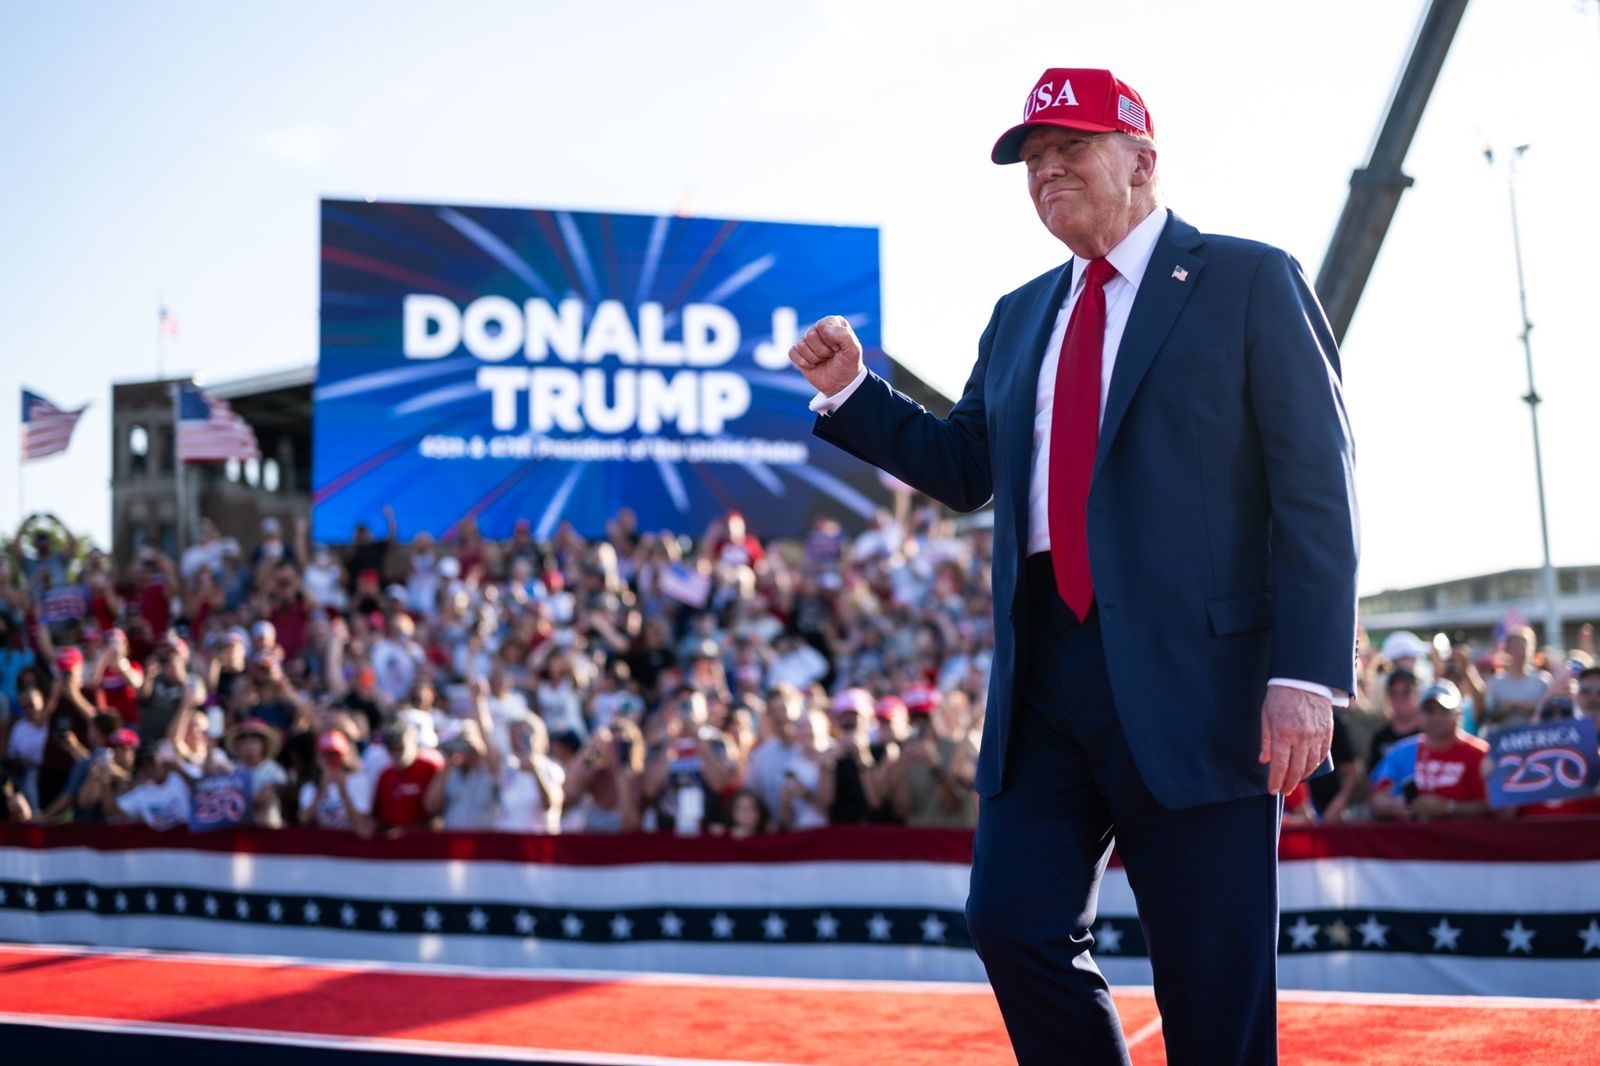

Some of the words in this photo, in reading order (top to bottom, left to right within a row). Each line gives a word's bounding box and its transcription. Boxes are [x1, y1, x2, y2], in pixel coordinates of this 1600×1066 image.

[1024, 79, 1080, 121] USA
[403, 294, 740, 366] DONALD
[475, 366, 751, 434] TRUMP
[1499, 726, 1581, 752] AMERICA
[1499, 748, 1587, 792] 250
